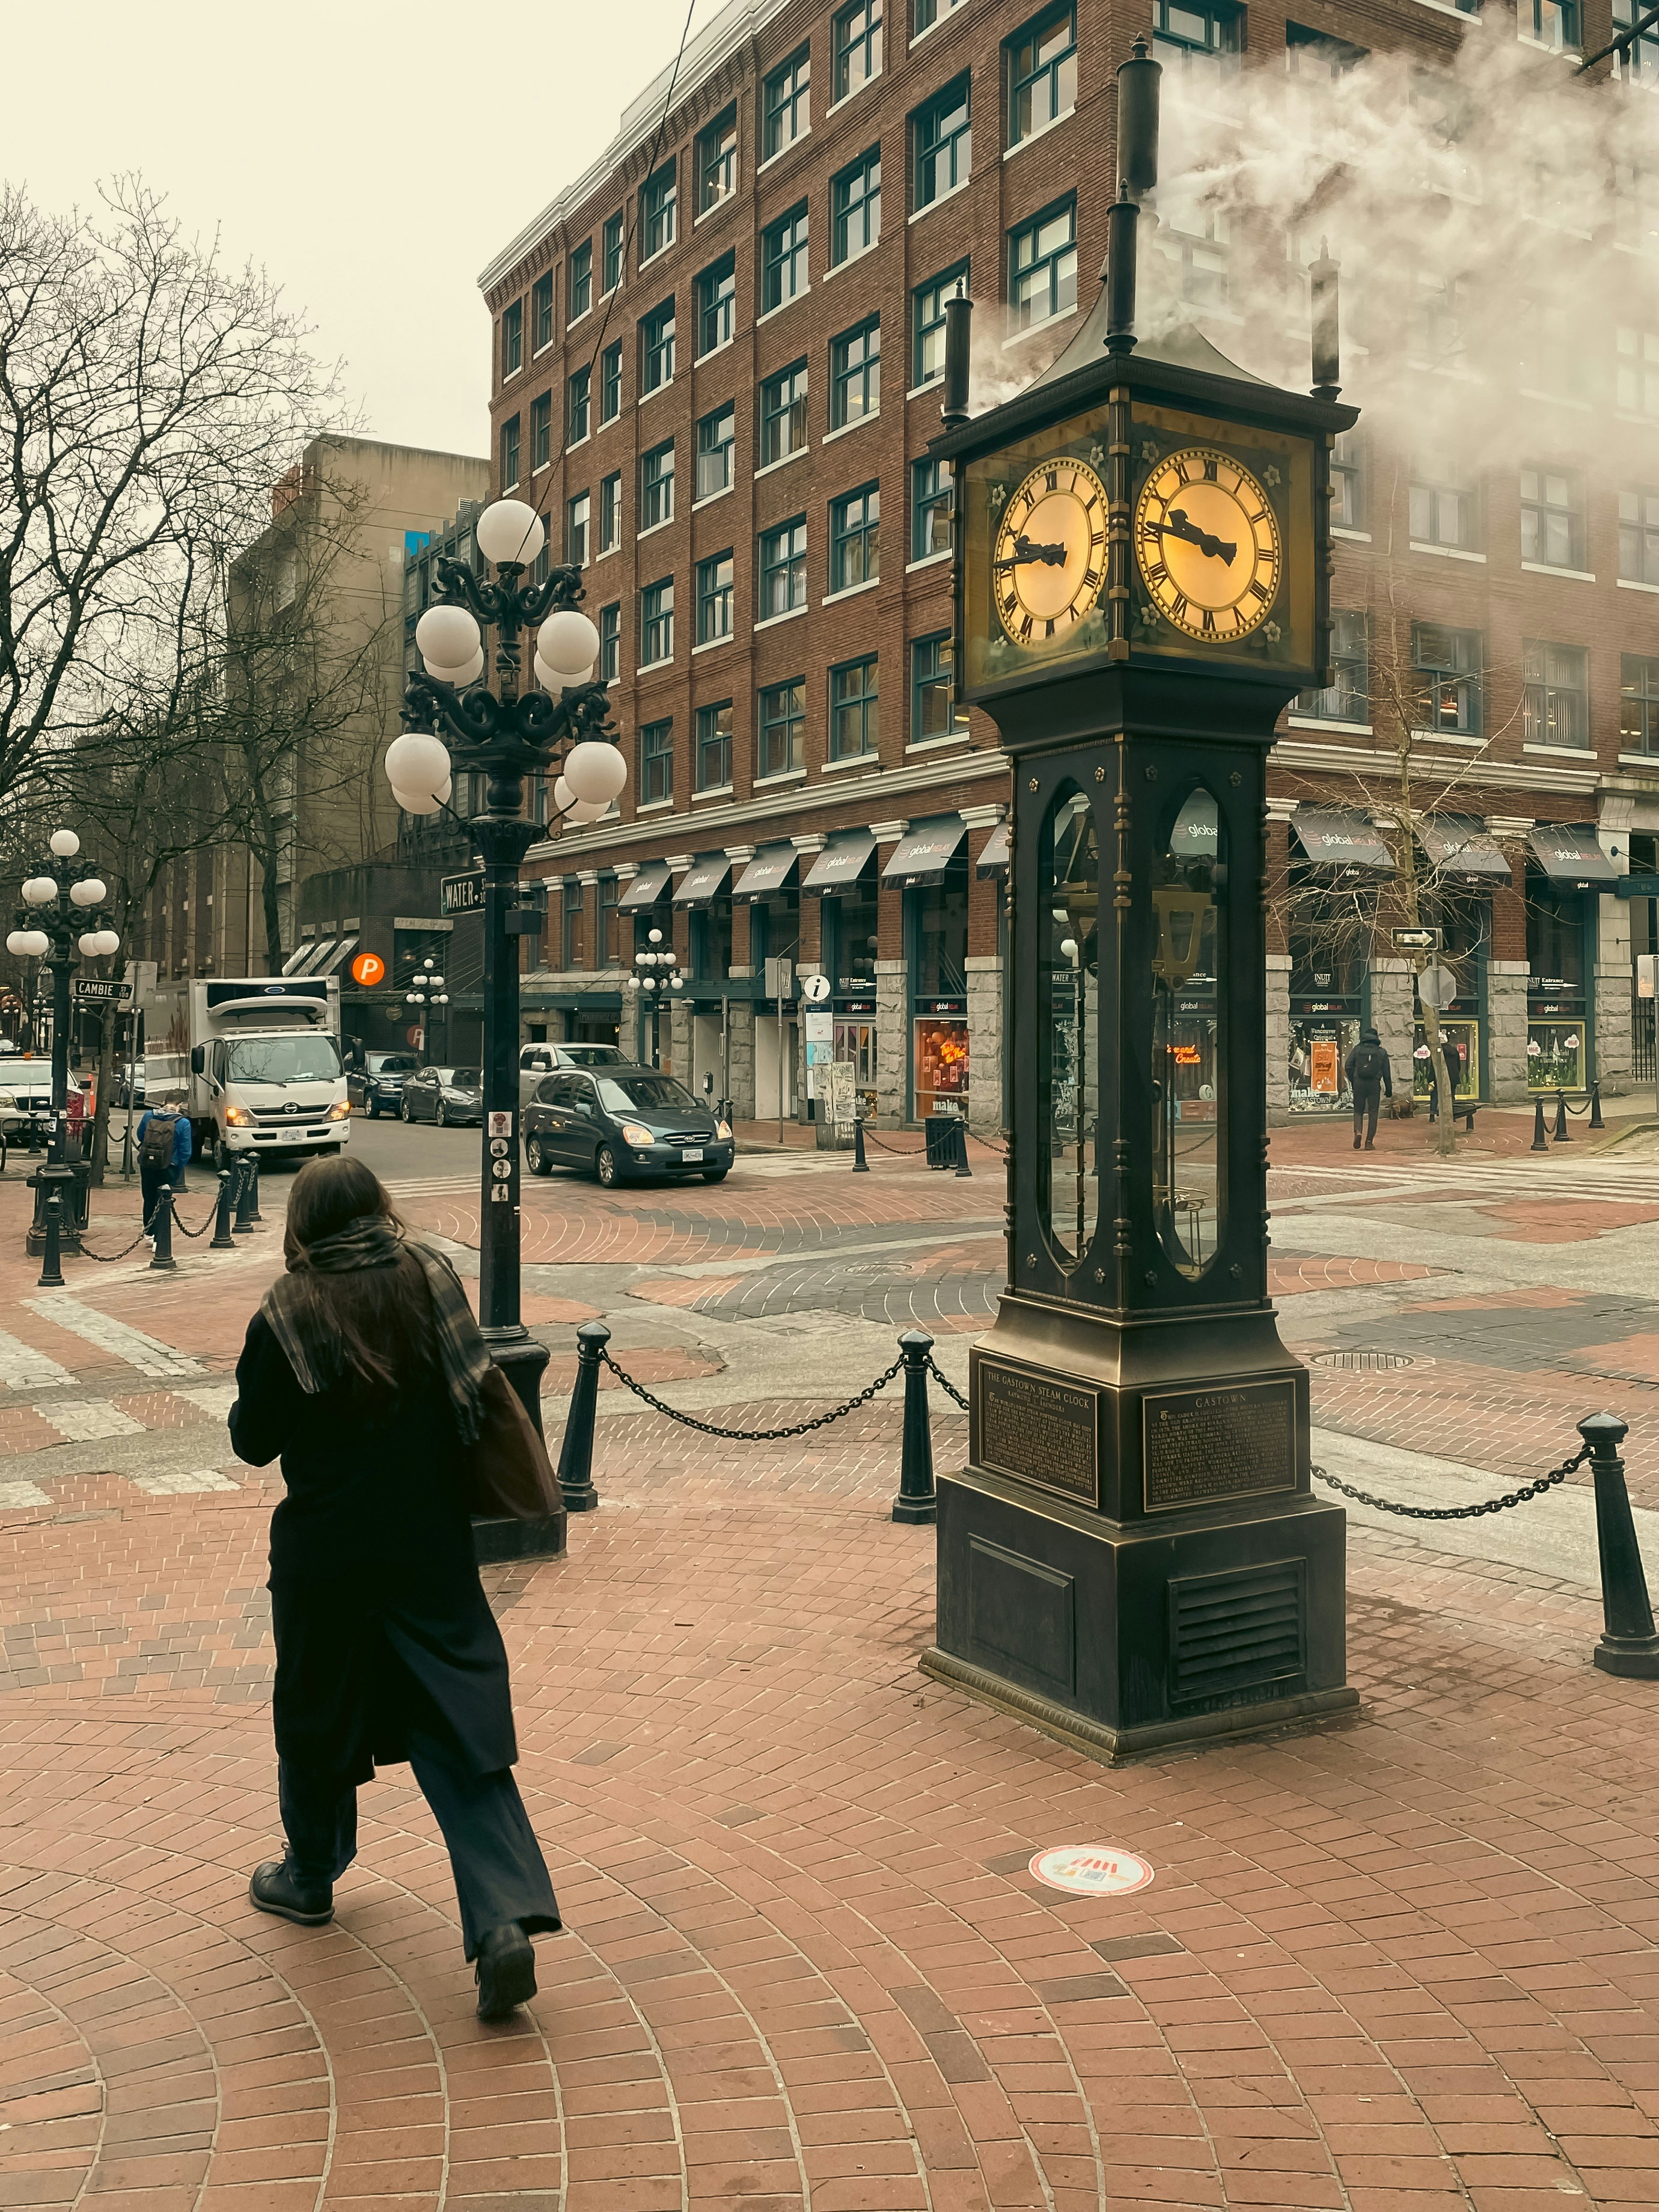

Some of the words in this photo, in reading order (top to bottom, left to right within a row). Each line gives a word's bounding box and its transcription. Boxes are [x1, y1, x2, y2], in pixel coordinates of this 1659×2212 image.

[1188, 824, 1218, 837] globa
[1322, 834, 1354, 846] global
[908, 843, 934, 858] global
[1554, 849, 1582, 861] global
[826, 855, 849, 870] global
[753, 866, 774, 878] global
[445, 881, 474, 909] WATER
[79, 983, 113, 995] CAMBIE
[936, 1002, 948, 1012] global
[1180, 1002, 1198, 1011] global
[1312, 1003, 1328, 1012] global
[1176, 1053, 1200, 1063] Create
[1291, 1087, 1320, 1098] make
[932, 1099, 958, 1111] make
[988, 1371, 999, 1382] THE
[1002, 1375, 1035, 1393] GASTOWN
[1038, 1386, 1060, 1401] STEAM
[1063, 1393, 1089, 1408] CLOCK
[1196, 1393, 1246, 1408] GASTOWN
